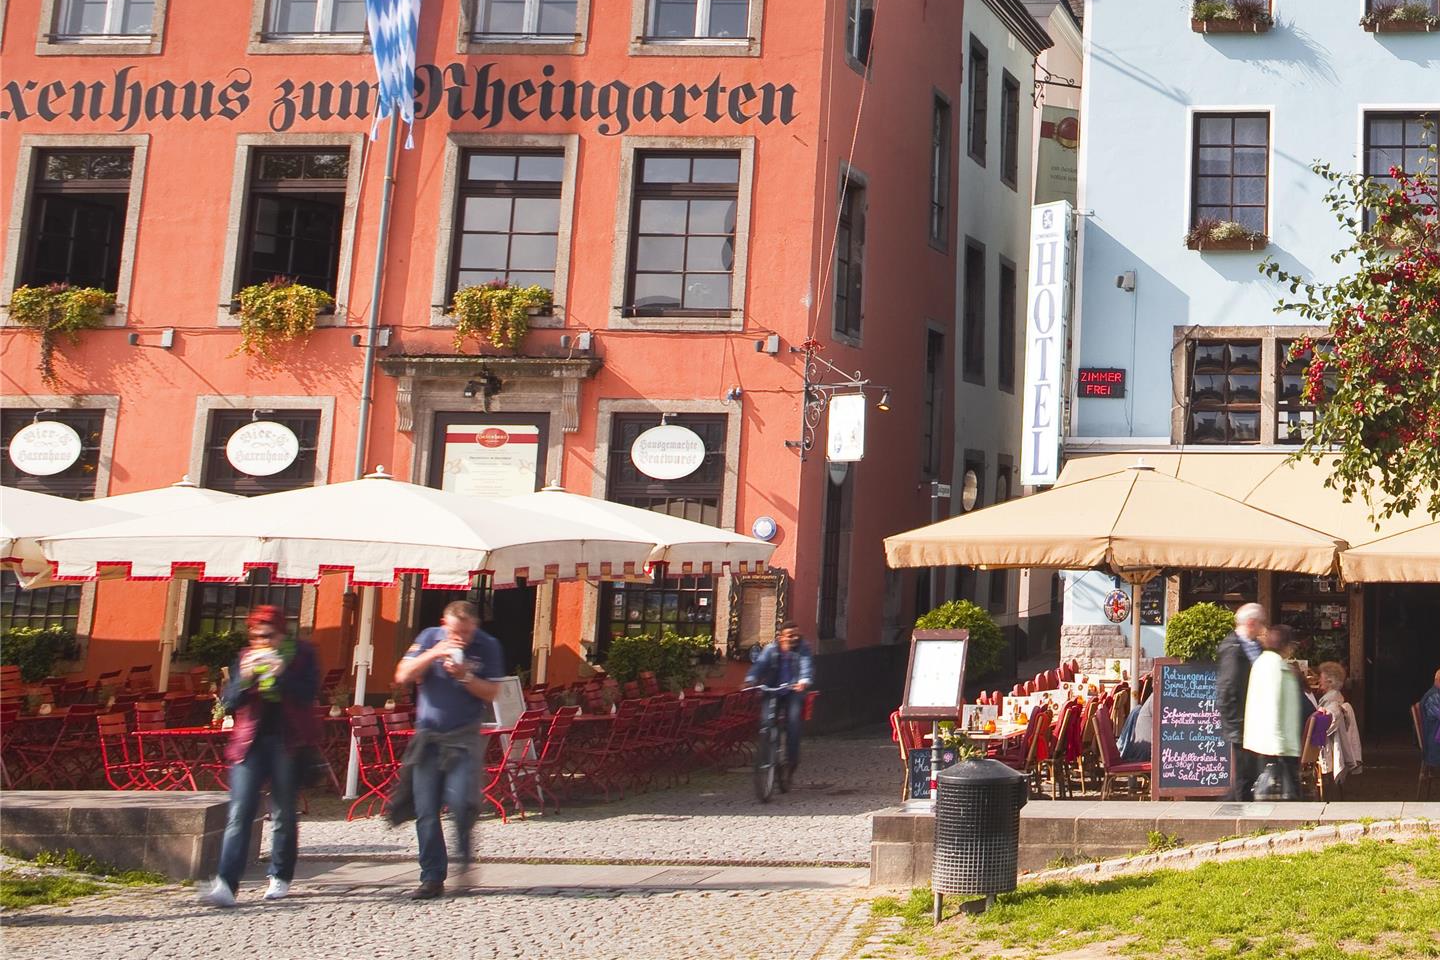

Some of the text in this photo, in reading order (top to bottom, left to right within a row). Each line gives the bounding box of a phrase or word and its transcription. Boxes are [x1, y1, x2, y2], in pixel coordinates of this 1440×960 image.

[415, 62, 801, 137] Rheingarten
[1031, 241, 1057, 476] HOTEL
[1080, 371, 1122, 383] ZIMMER
[1086, 384, 1111, 395] FREI
